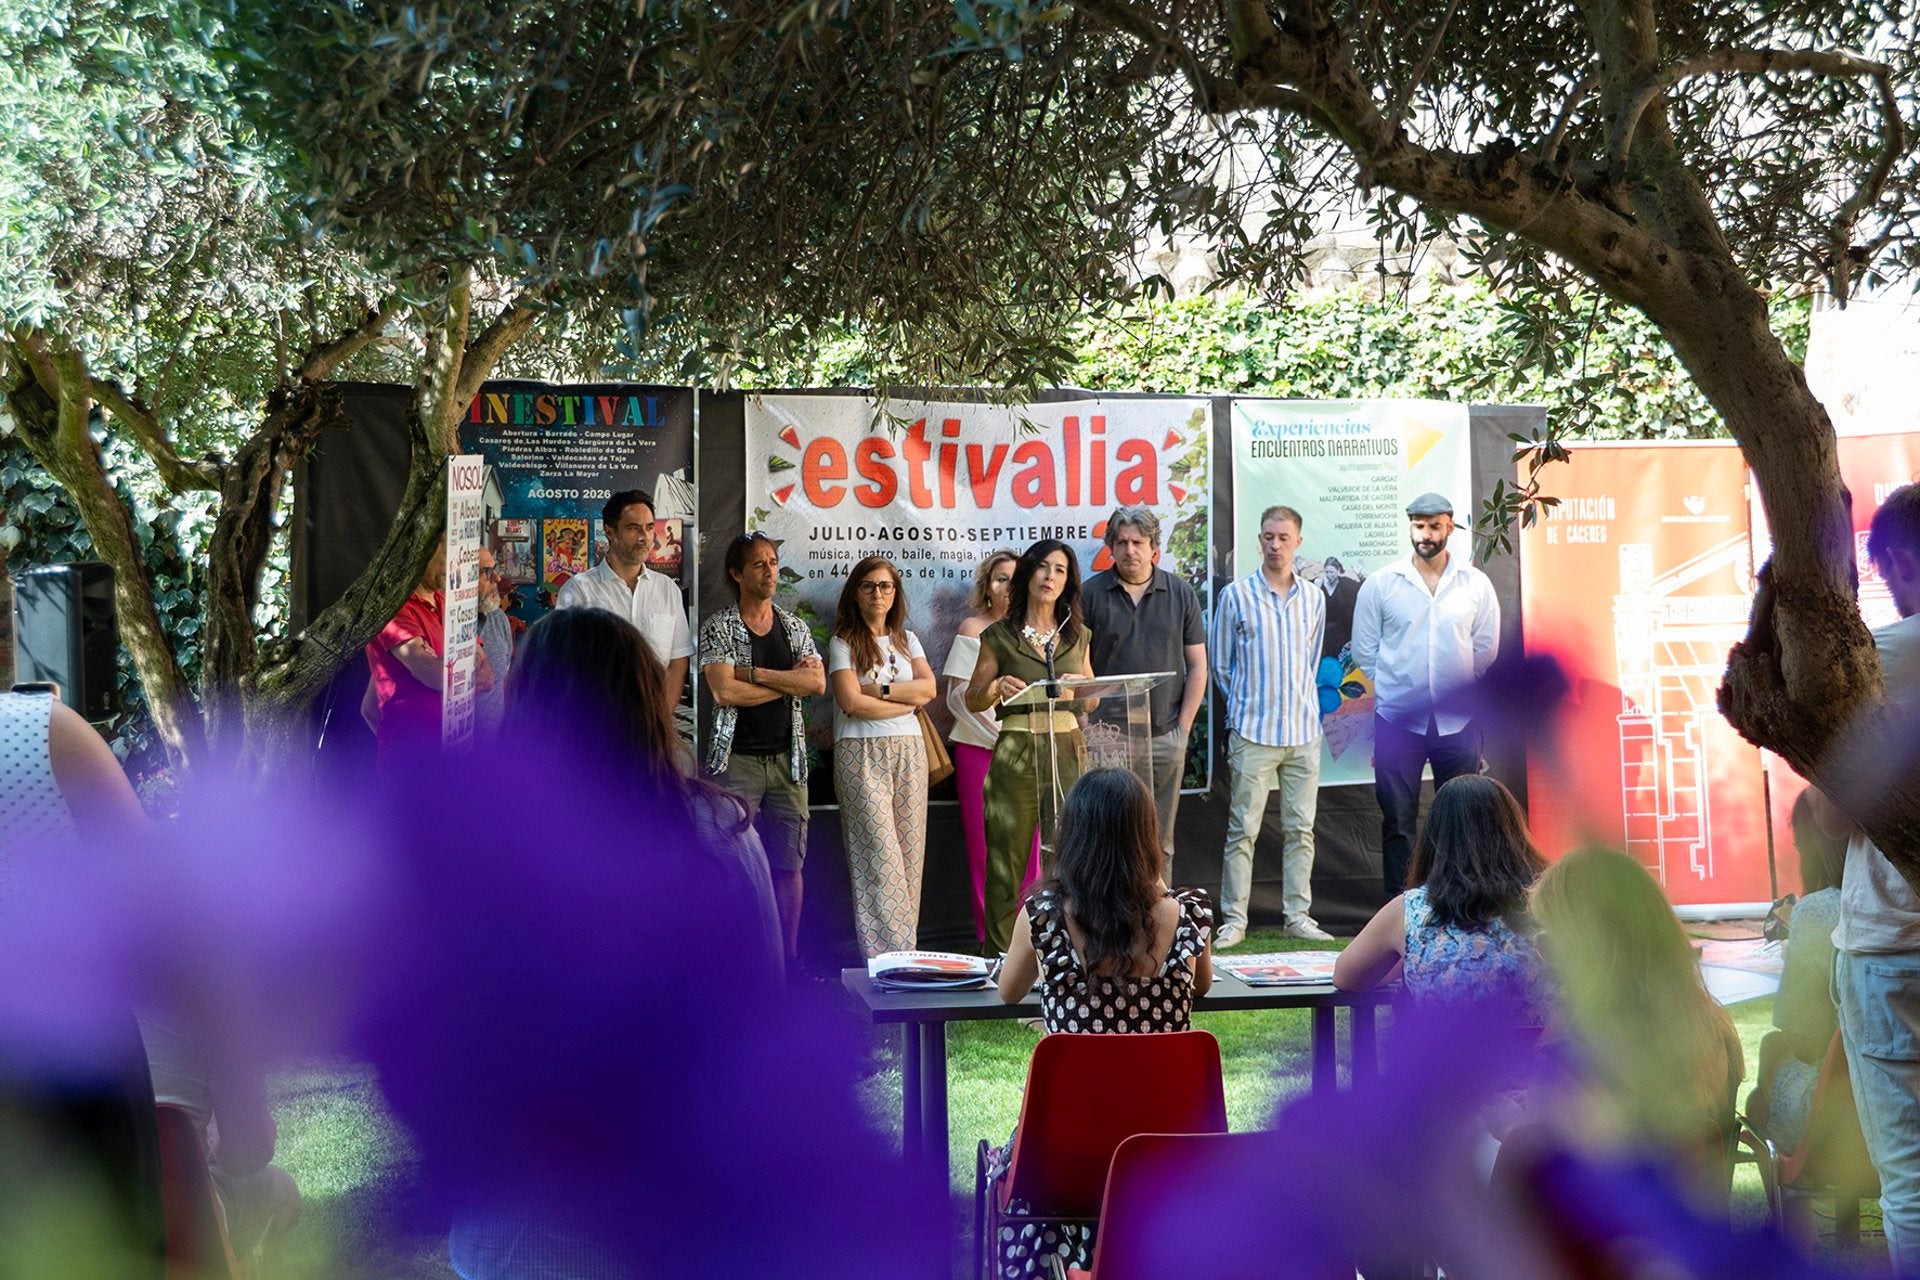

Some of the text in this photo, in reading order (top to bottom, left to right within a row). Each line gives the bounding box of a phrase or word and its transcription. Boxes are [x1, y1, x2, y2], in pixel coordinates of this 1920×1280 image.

[469, 393, 667, 427] INESTIVAL
[545, 430, 578, 438] Barrado
[585, 431, 610, 439] Campo
[613, 431, 635, 440] Lugar
[1251, 418, 1371, 440] Experiencias
[1251, 438, 1399, 458] ENCUENTROS NARRATIVOS
[551, 454, 597, 462] Valdecañas
[610, 455, 626, 463] Tajo
[802, 415, 1160, 509] estivalia
[498, 462, 547, 470] Valdeobispo
[576, 471, 599, 479] Mayor
[528, 489, 611, 499] AGOSTO 2026
[1334, 522, 1362, 530] HIGUERA
[1546, 523, 1607, 545] DE CÁCERES
[808, 549, 854, 561] música,
[858, 549, 897, 561] teatro,
[902, 549, 936, 562] baile,
[940, 549, 977, 563] magia,
[809, 568, 824, 579] en
[831, 563, 849, 579] 44
[919, 566, 935, 579] de
[942, 566, 954, 579] la
